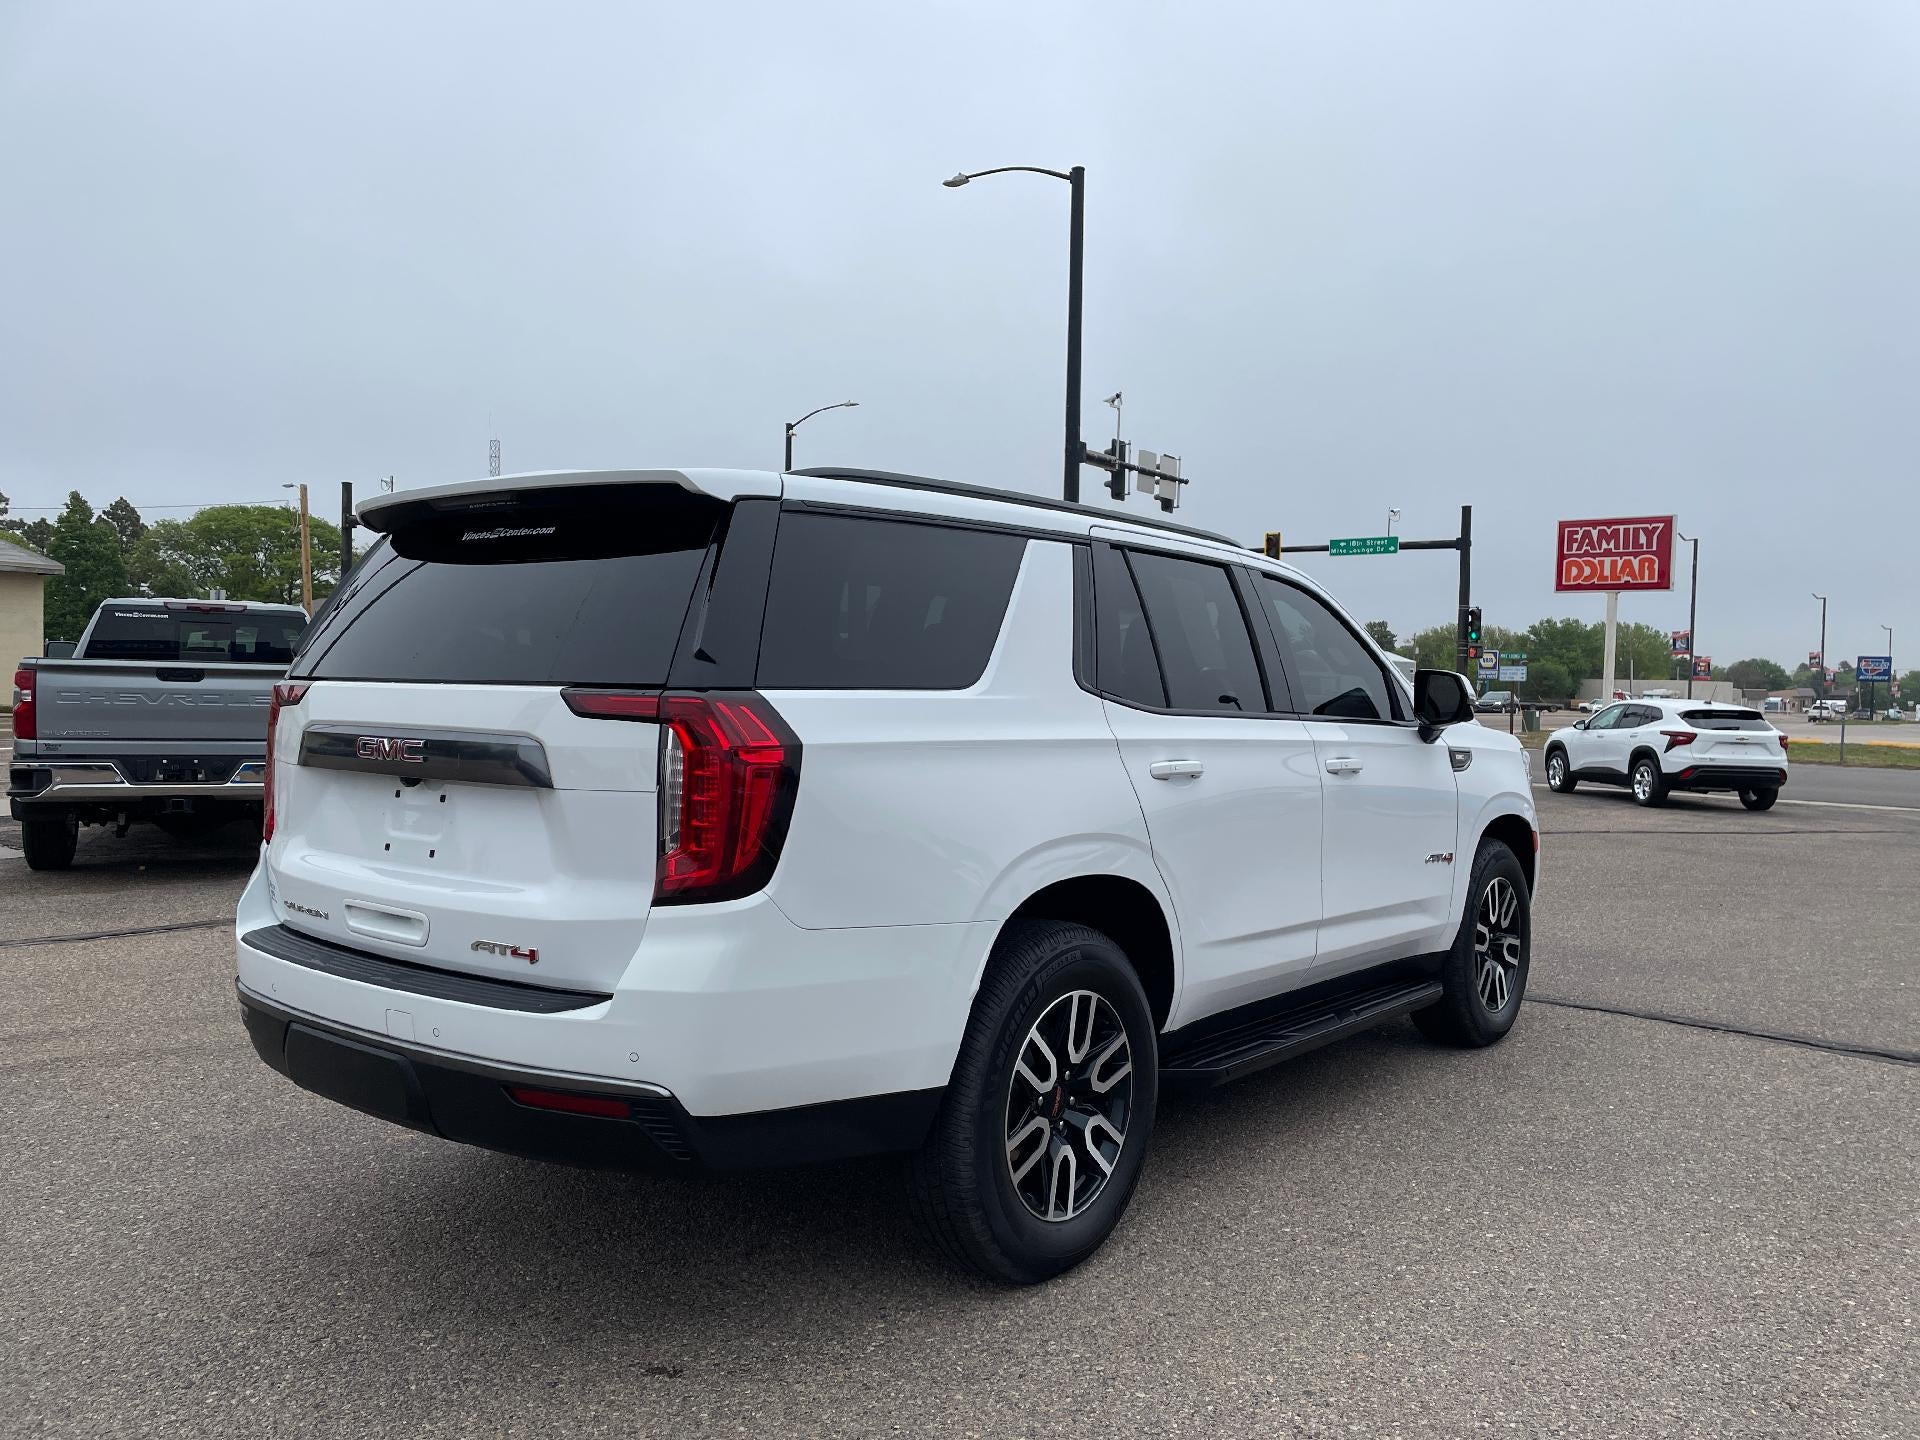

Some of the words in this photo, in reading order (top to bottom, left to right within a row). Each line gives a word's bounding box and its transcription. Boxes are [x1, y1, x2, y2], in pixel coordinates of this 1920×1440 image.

[1563, 522, 1664, 554] FAMILY
[1562, 554, 1659, 585] DOLLAR
[56, 690, 272, 707] CHEVROLE
[356, 736, 426, 763] GMC
[470, 939, 540, 965] AT4
